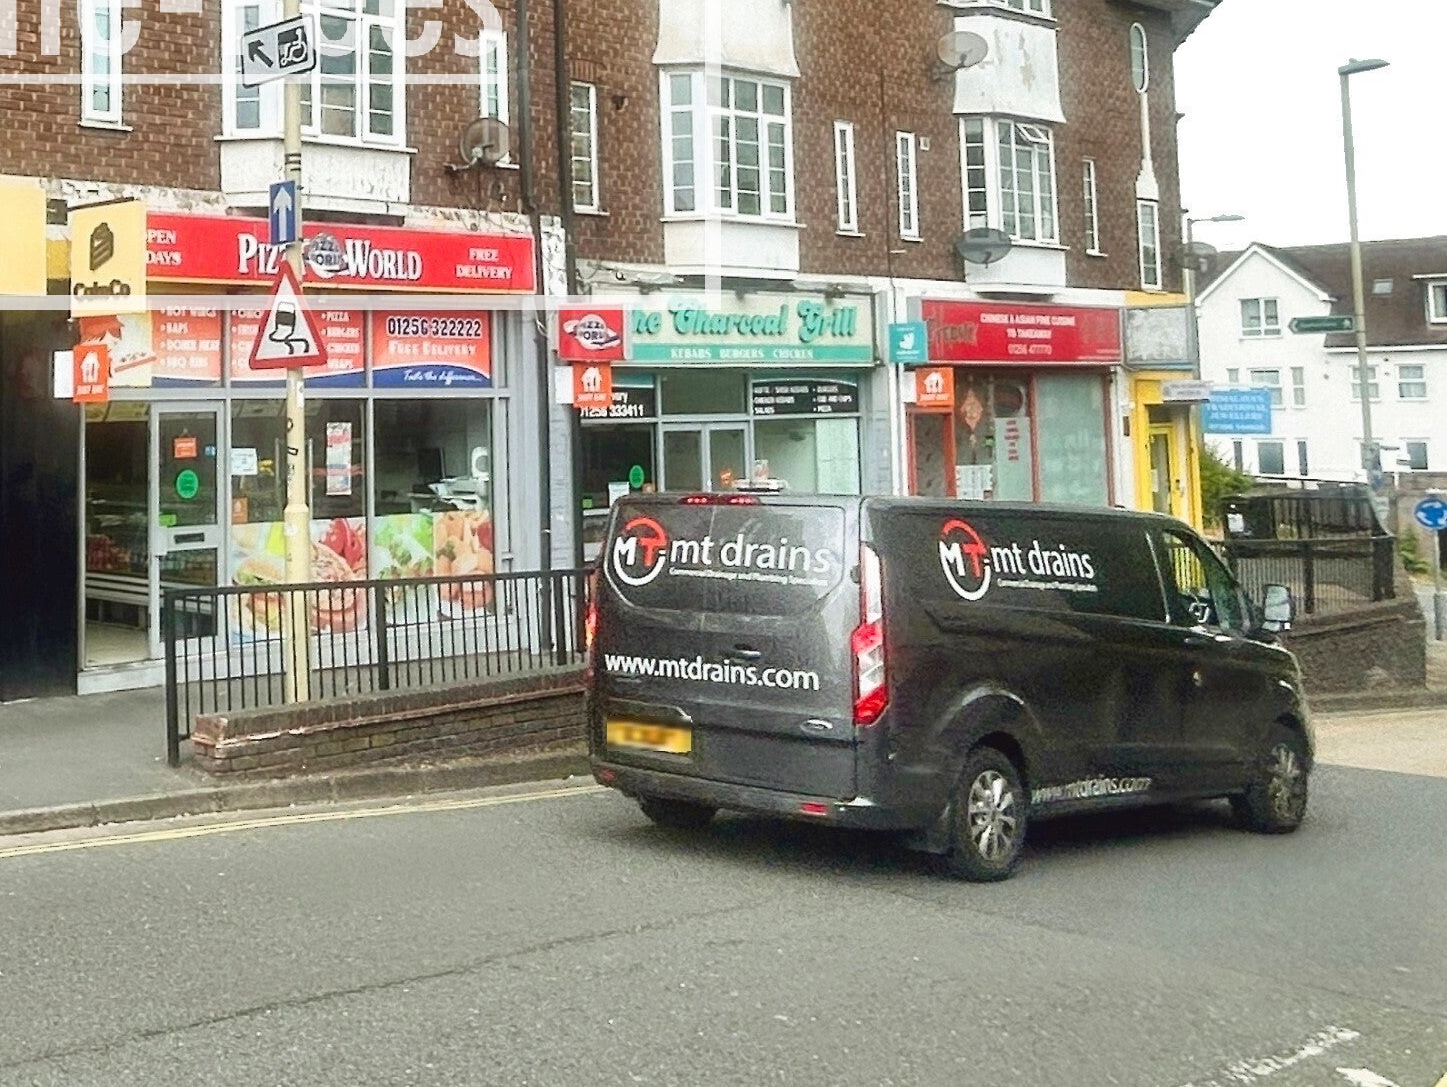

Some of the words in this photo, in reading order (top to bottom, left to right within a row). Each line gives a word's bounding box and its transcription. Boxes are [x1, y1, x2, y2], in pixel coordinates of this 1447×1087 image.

[147, 229, 177, 245] PEN
[469, 248, 499, 262] FREE
[346, 237, 423, 280] WORLD
[456, 266, 513, 280] DELIVERY
[632, 303, 662, 334] he
[668, 297, 789, 336] Charcoal
[797, 300, 856, 344] Grill
[670, 348, 712, 359] KEBABS
[719, 348, 765, 359] BURGERS
[772, 348, 814, 359] CHICKEN
[670, 534, 714, 565] mt
[720, 533, 834, 574] drains
[991, 542, 1026, 574] mt
[1028, 540, 1095, 579] drains
[605, 653, 820, 691] www.mtdrains.com
